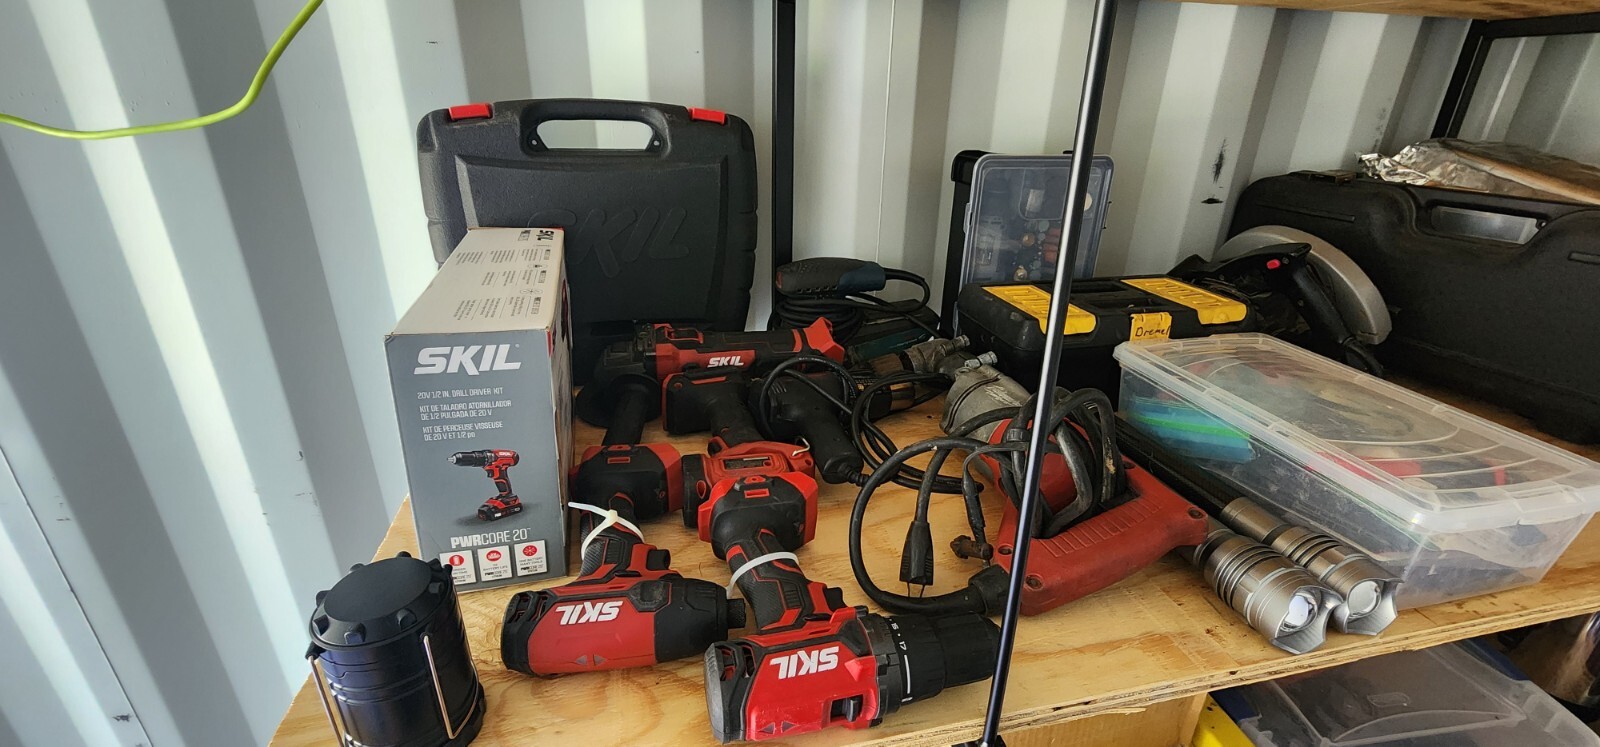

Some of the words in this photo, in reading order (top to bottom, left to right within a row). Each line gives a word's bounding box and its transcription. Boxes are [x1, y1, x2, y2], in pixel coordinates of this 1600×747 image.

[1135, 325, 1170, 338] Dremel
[414, 344, 522, 376] SKIL
[706, 355, 745, 368] SKIL
[452, 389, 468, 397] DRILL
[469, 388, 492, 396] DRIVER
[493, 387, 503, 395] KIT
[440, 403, 467, 411] TALADRO
[468, 400, 512, 409] ATORNILLADOR
[441, 411, 469, 419] PULGADA
[443, 423, 474, 432] PERCEUSE
[474, 421, 503, 430] VISSEUSE
[450, 531, 511, 549] PWRCORE
[512, 528, 528, 541] 20
[555, 600, 624, 626] SKIL
[899, 641, 907, 650] 17
[770, 646, 840, 680] SKIL
